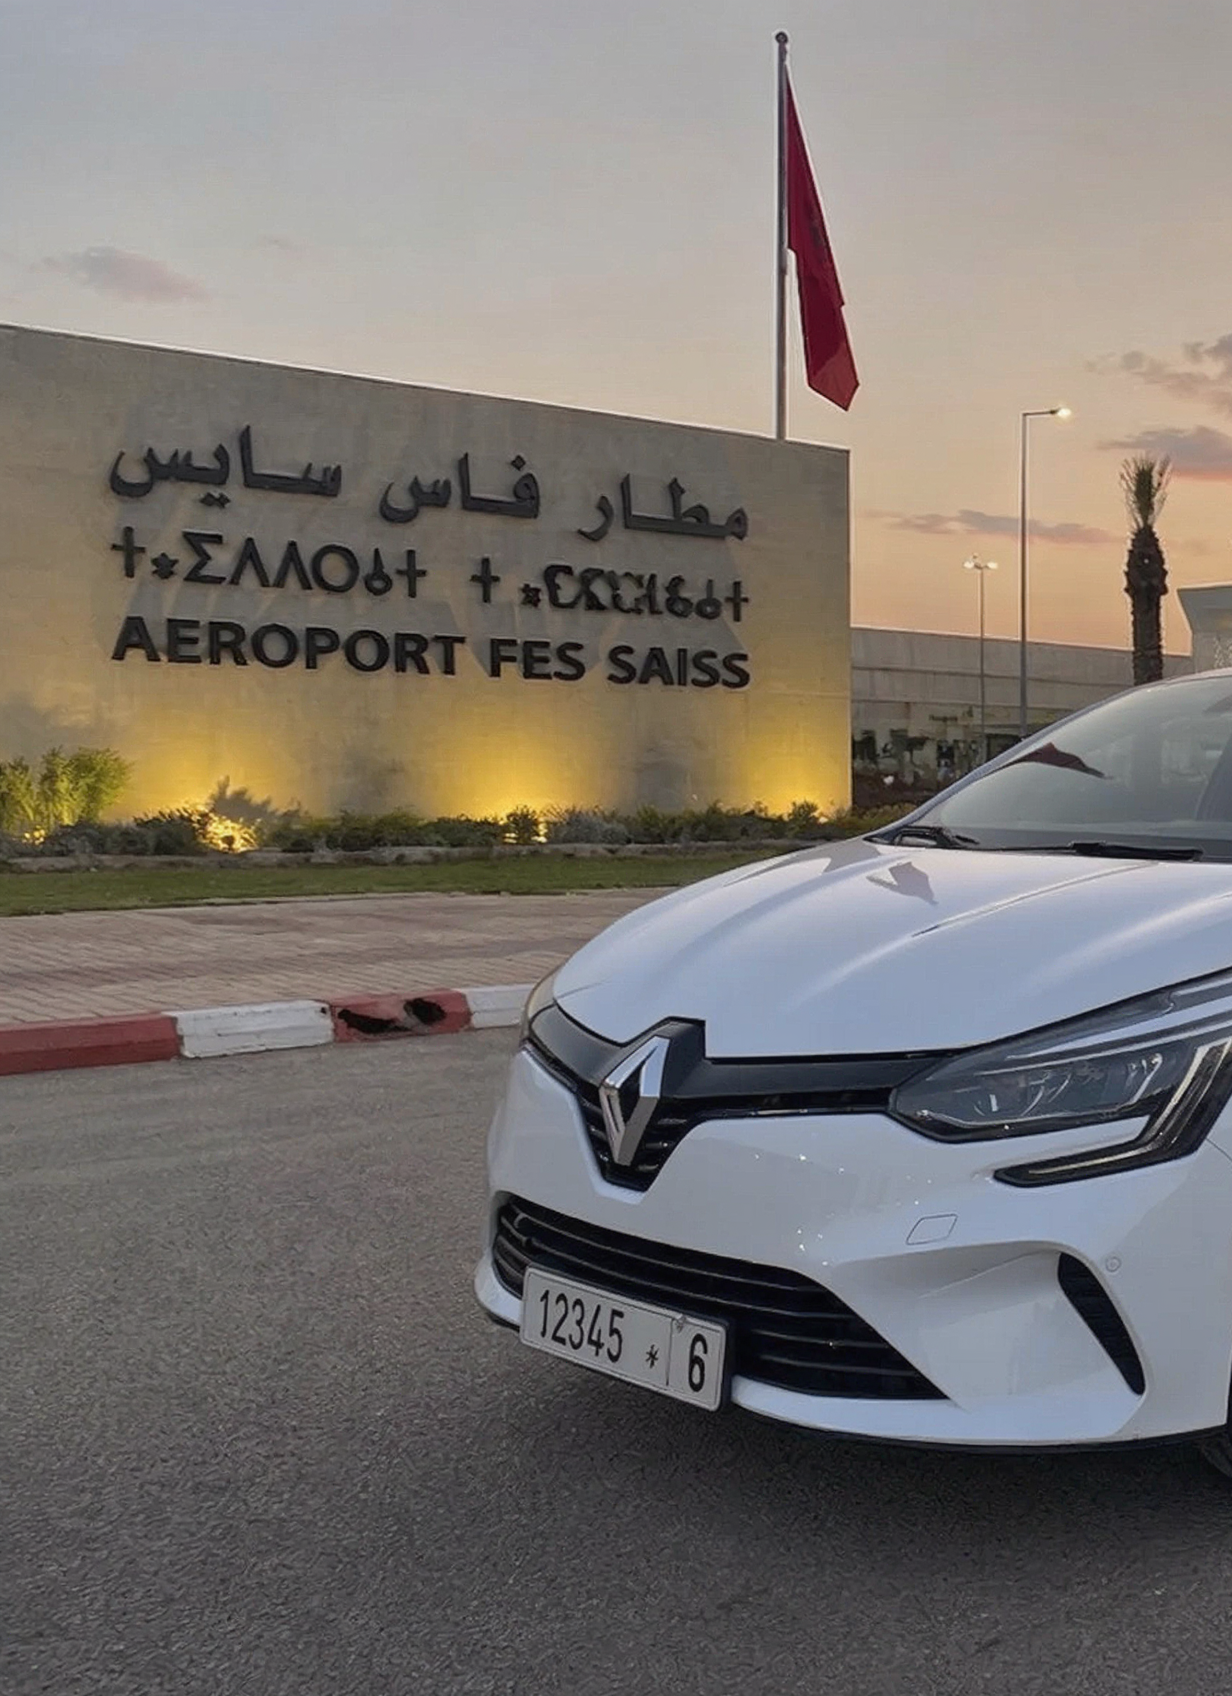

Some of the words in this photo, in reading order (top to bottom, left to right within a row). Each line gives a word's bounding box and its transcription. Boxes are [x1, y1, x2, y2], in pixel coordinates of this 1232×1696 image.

[109, 425, 342, 509] سايس
[379, 452, 540, 522] فاس
[577, 473, 748, 541] مطار
[111, 616, 466, 676] AEROPORT
[489, 638, 586, 680] FES
[607, 645, 750, 688] SAISS
[540, 1289, 624, 1363] 12345
[688, 1333, 708, 1393] 6
